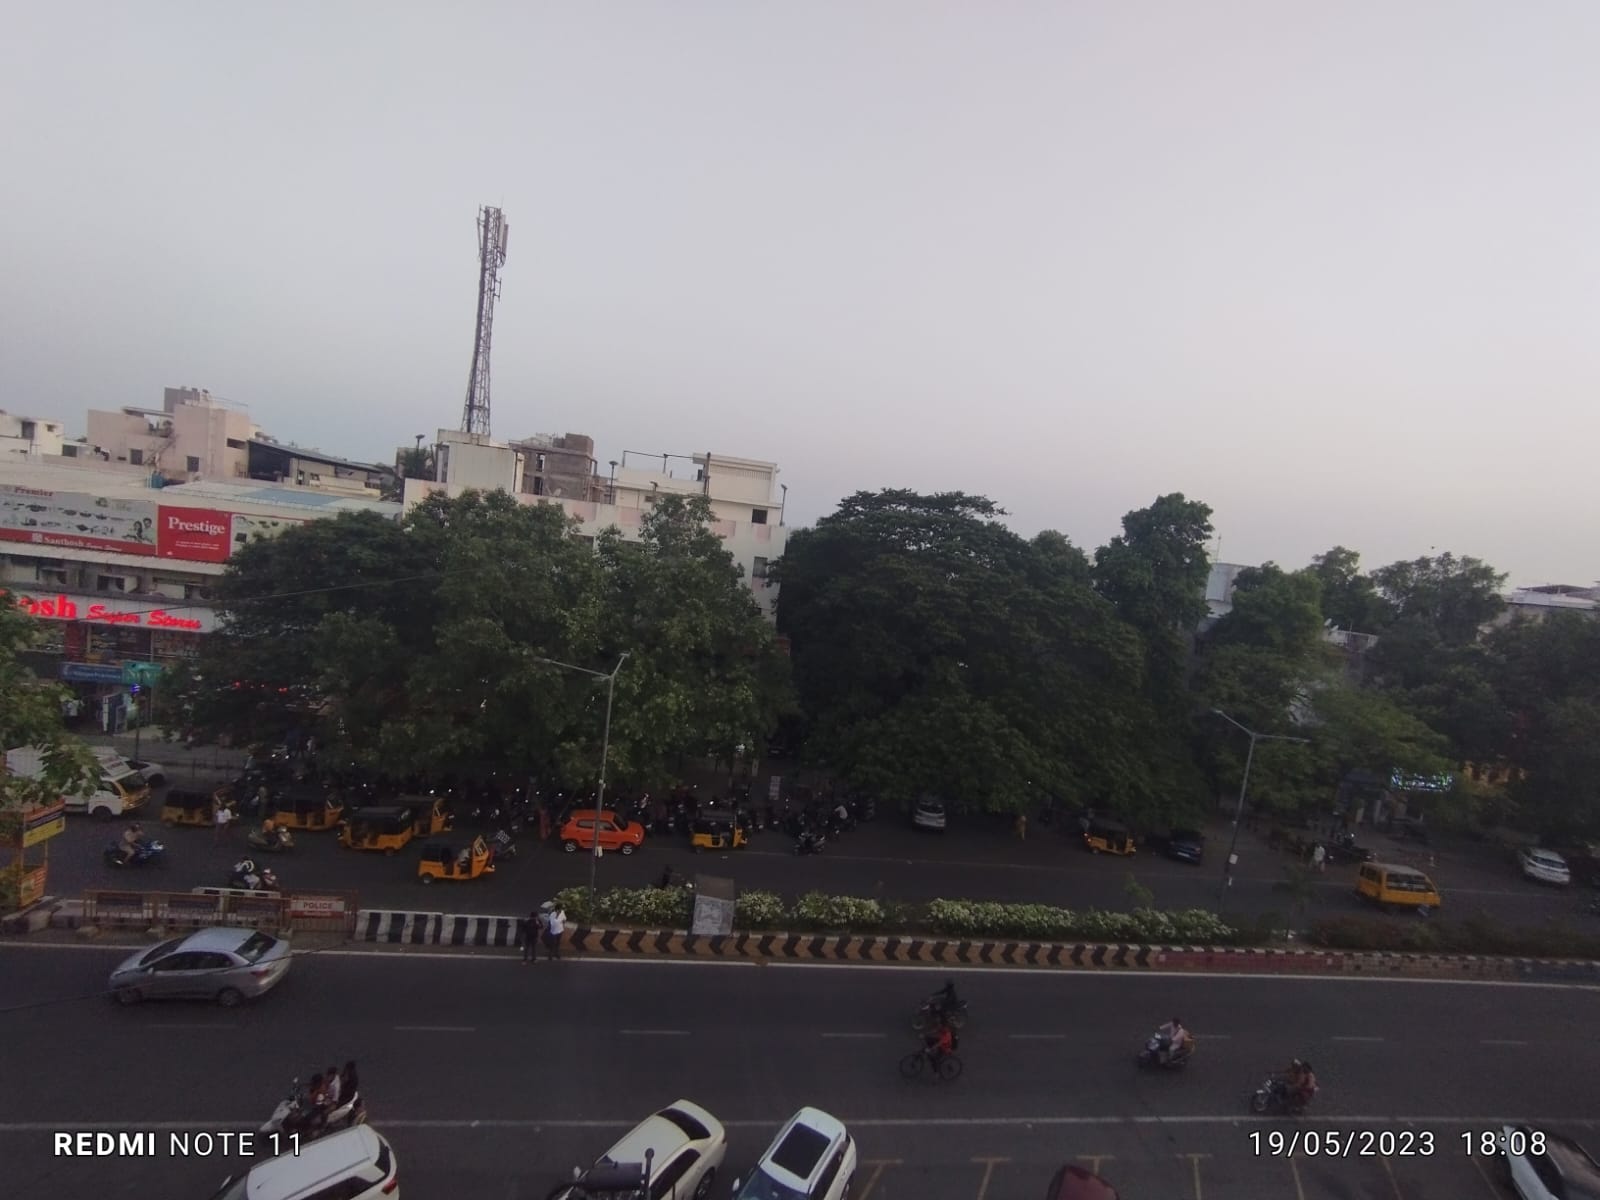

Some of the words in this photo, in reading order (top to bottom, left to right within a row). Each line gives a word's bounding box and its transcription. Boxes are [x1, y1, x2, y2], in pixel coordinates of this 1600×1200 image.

[14, 486, 54, 497] Premier
[167, 516, 226, 536] Prestige
[43, 536, 84, 548] Santhosh
[86, 605, 140, 625] Super
[148, 609, 202, 630] Stores
[303, 902, 333, 910] POLICE
